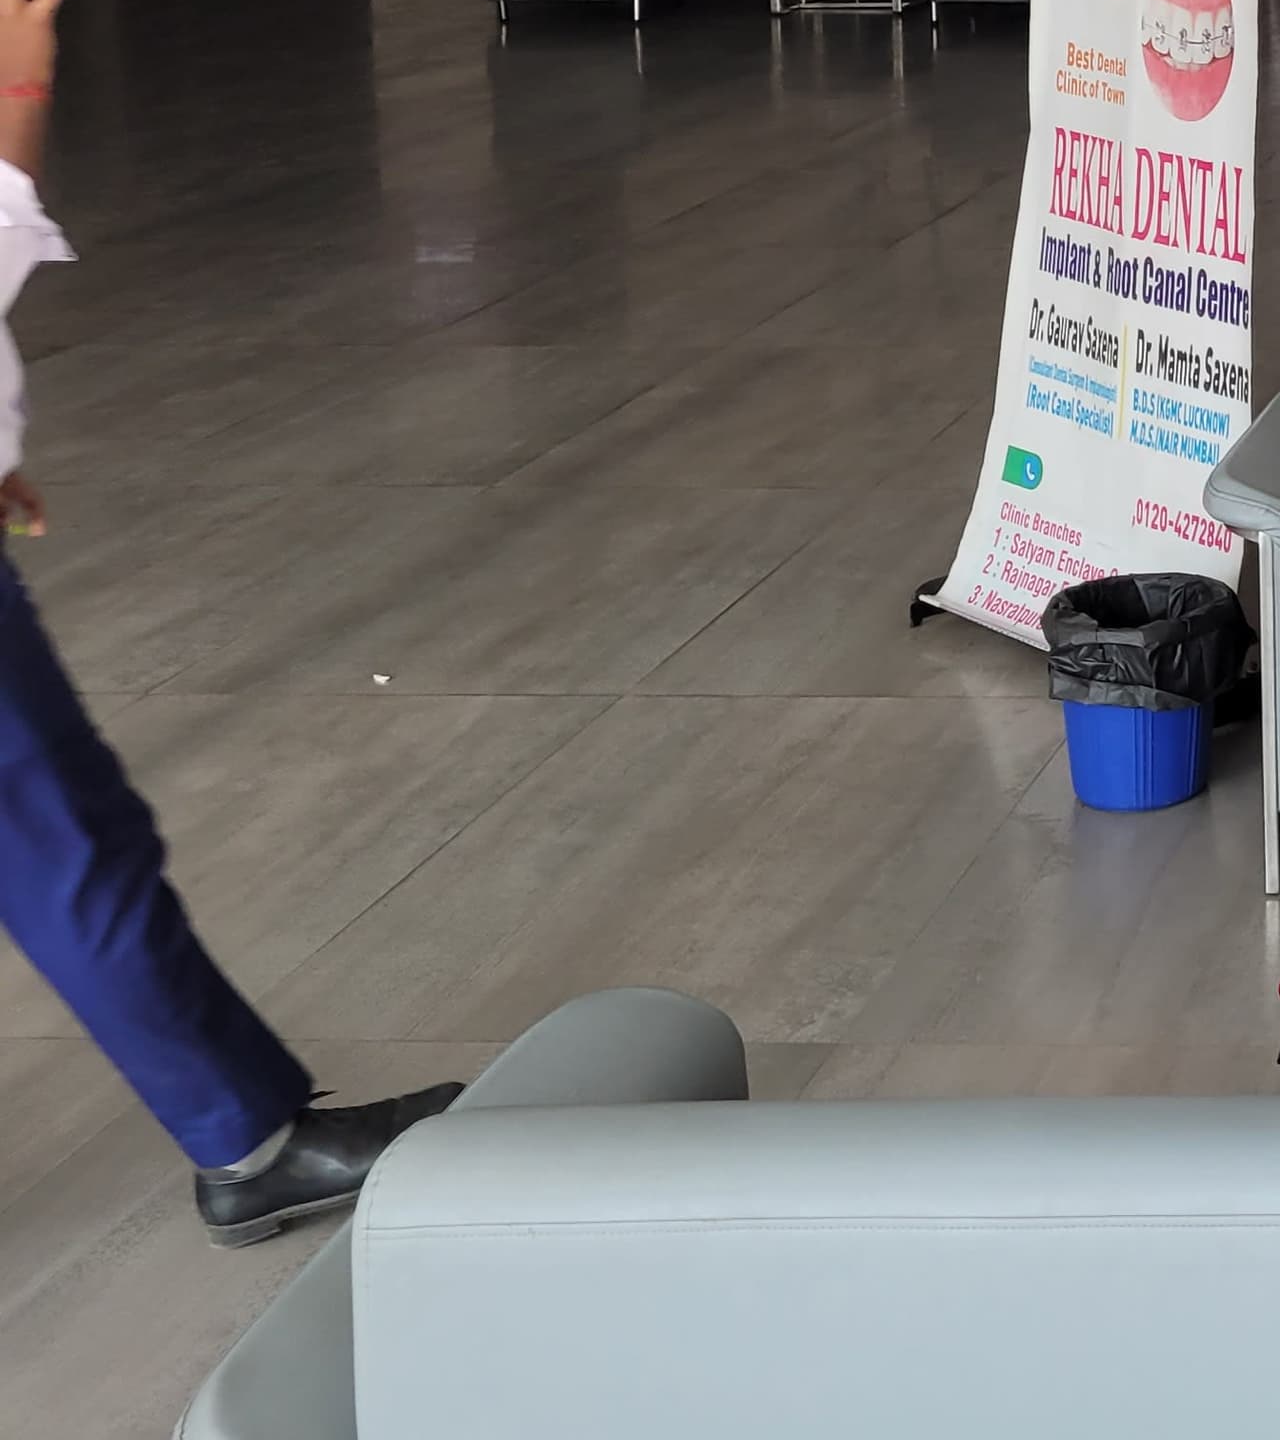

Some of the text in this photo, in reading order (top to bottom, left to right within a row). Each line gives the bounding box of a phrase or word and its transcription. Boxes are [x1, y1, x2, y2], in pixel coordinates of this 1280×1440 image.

[1067, 42, 1127, 77] Best Dental
[1056, 69, 1125, 106] Clinic of Town
[1049, 127, 1247, 264] REKHA DENTAL
[1039, 226, 1249, 330] Implant & Root Canal Centre
[1029, 298, 1119, 368] Dr. Gaurav Saxena
[1136, 329, 1153, 376] Dr.
[1157, 334, 1200, 389] Mamta
[1204, 346, 1249, 404] Saxena
[1051, 392, 1075, 421] Canal
[1000, 502, 1082, 547] Clinic Branches
[1000, 559, 1057, 598] Rajnagar
[1010, 533, 1056, 569] Satyam
[1057, 550, 1105, 580] Enclave
